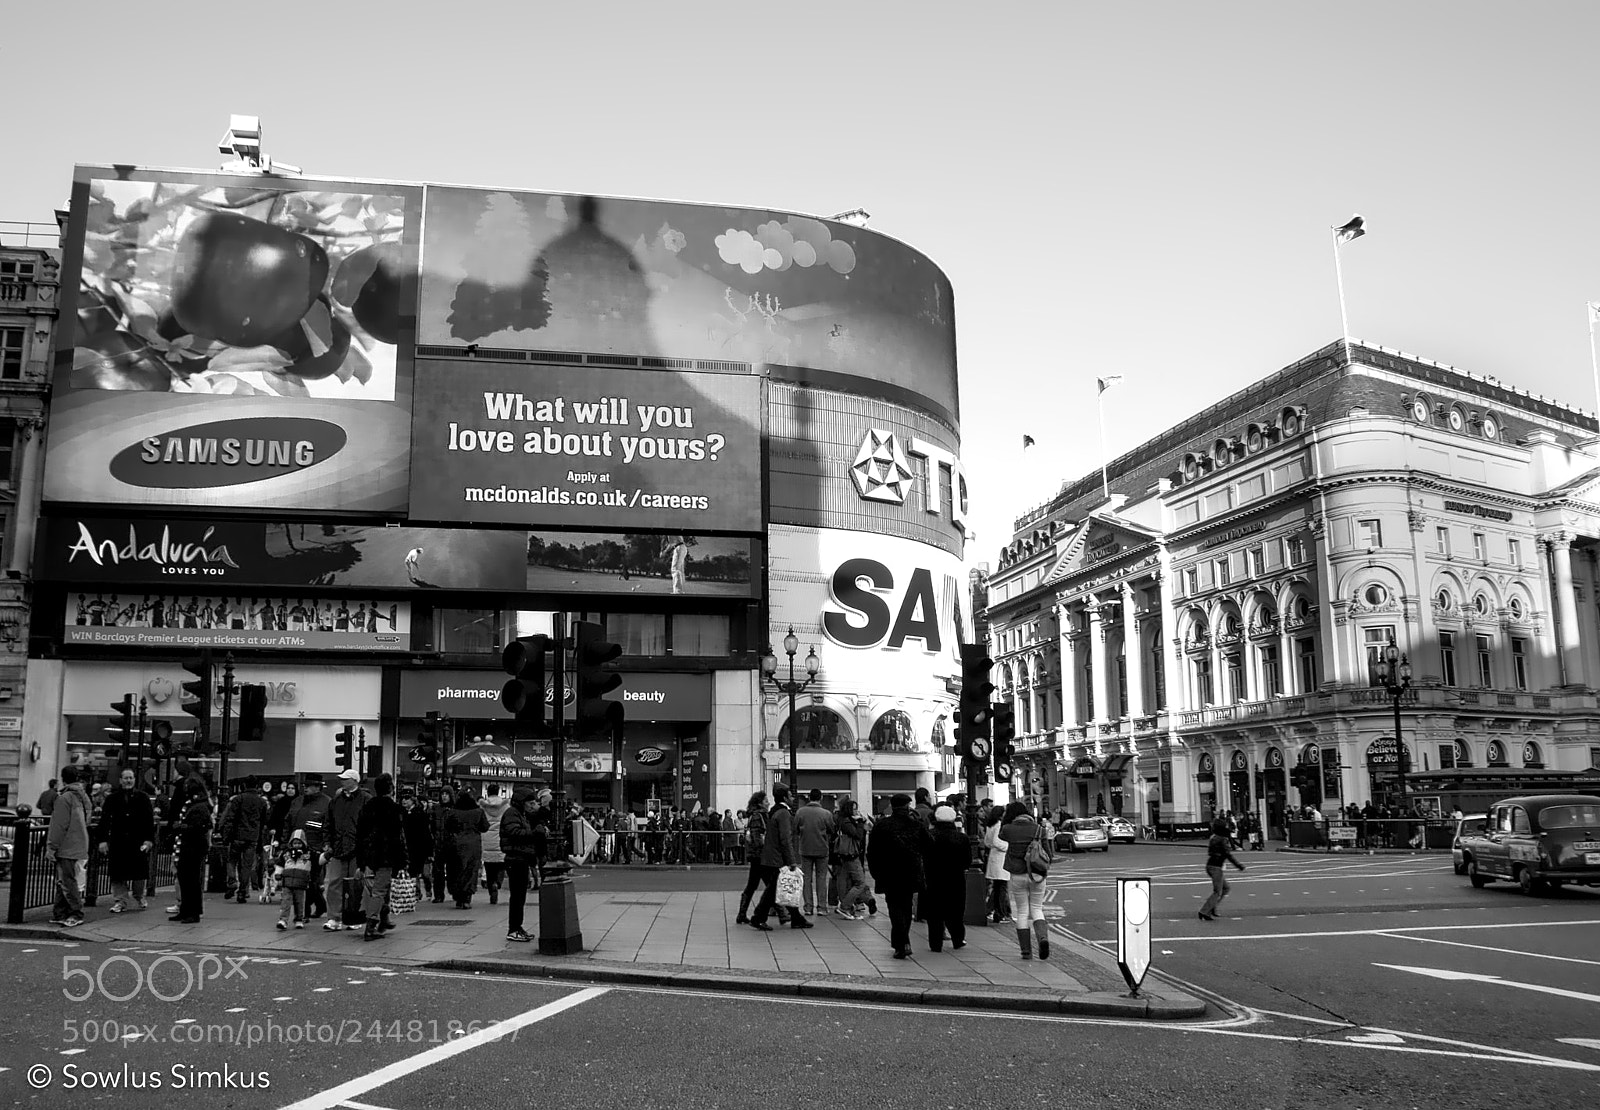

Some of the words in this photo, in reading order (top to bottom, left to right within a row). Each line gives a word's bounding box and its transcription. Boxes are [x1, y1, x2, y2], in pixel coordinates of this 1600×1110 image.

[484, 392, 564, 423] What
[573, 397, 628, 425] will
[636, 404, 693, 432] you
[448, 423, 514, 452] love
[524, 427, 613, 457] about
[620, 433, 725, 464] yours?
[141, 437, 314, 466] SAMSUNG
[567, 471, 597, 483] Apply
[600, 473, 610, 482] at
[69, 522, 240, 568] Andalucía
[162, 567, 197, 575] LOVES
[203, 568, 224, 576] YOU
[71, 631, 92, 640] WIN
[95, 632, 136, 643] Barclays
[138, 633, 174, 644] Premier
[176, 634, 211, 646] League
[213, 635, 245, 645] tickets
[248, 637, 258, 645] at
[261, 638, 276, 646] our
[278, 636, 305, 646] ATMs
[438, 686, 500, 700] pharmacy
[624, 689, 665, 703] beauty
